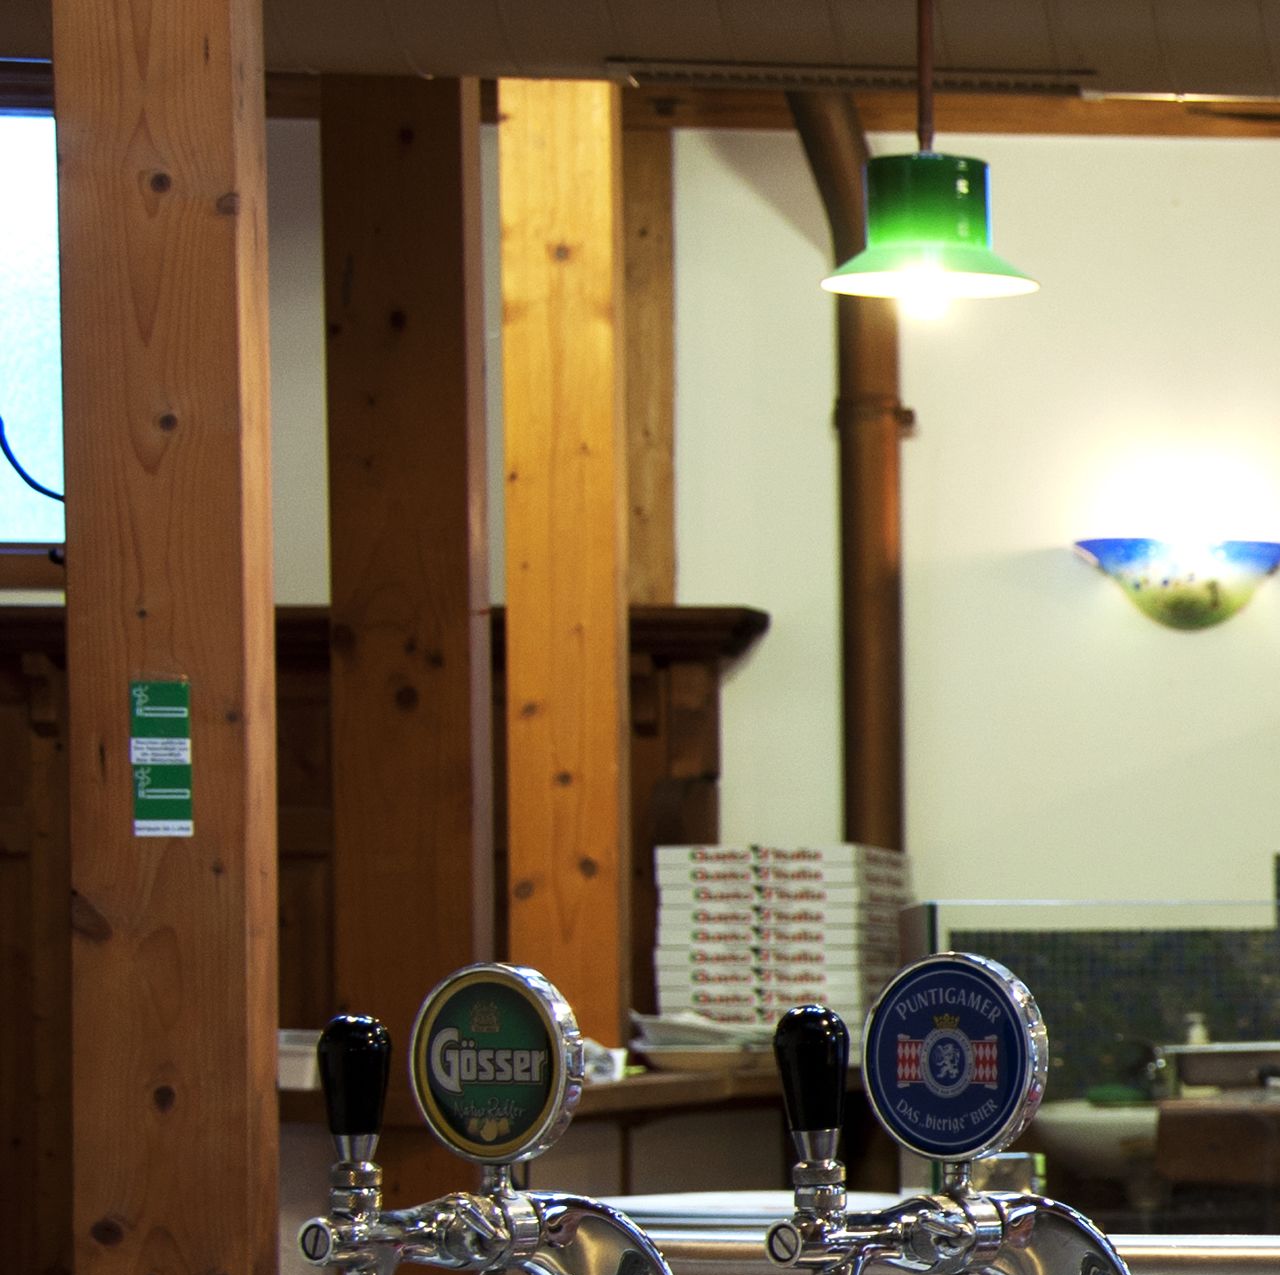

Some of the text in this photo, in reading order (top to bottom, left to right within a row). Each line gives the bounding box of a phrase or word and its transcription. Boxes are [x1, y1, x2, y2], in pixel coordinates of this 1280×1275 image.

[895, 987, 1002, 1025] PUNTIGAMER
[430, 1027, 546, 1093] Gösser
[897, 1100, 919, 1125] DAS
[970, 1099, 998, 1125] BIER
